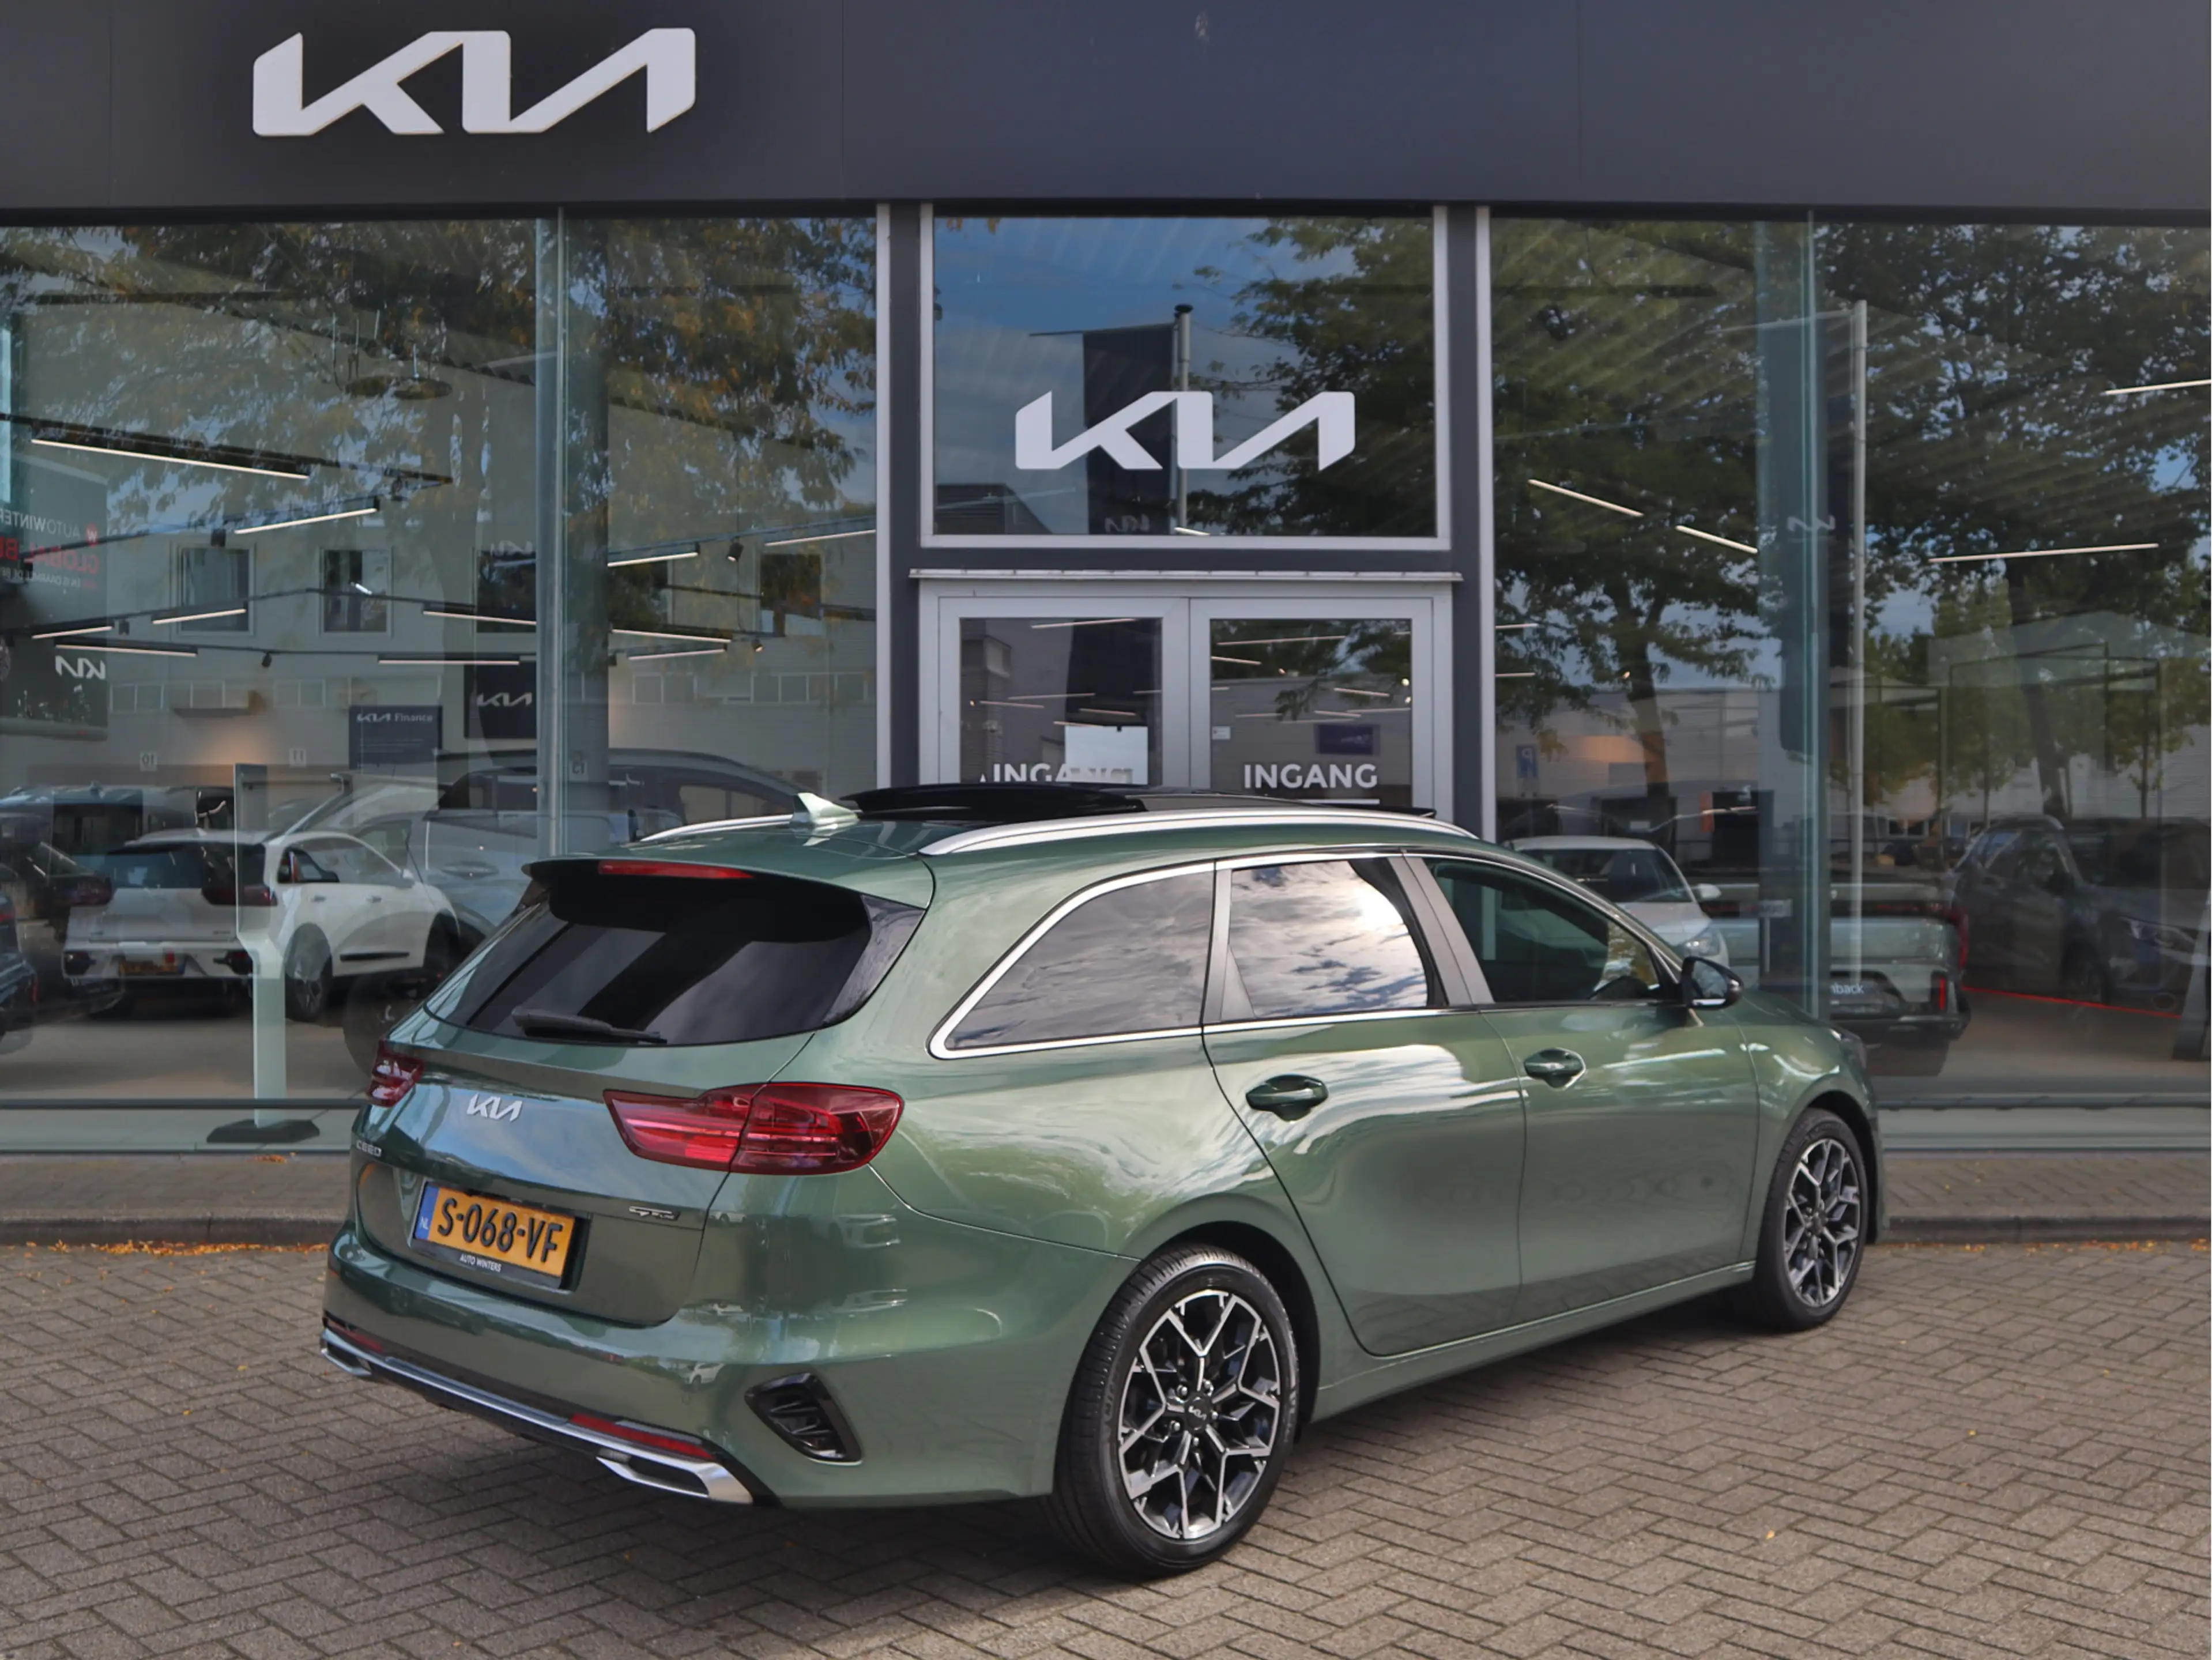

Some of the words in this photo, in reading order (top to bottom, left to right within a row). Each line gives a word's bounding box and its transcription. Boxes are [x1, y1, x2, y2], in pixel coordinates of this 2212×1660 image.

[253, 28, 696, 136] KIA
[1015, 391, 1355, 471] KIA
[476, 693, 532, 707] KIA
[357, 713, 391, 723] KIA
[394, 712, 433, 722] Finance
[1244, 764, 1378, 788] INGANG
[467, 1093, 523, 1122] KIA
[420, 1216, 429, 1231] NL
[438, 1197, 563, 1263] S-068-VF
[459, 1253, 476, 1266] AUTO
[476, 1257, 502, 1273] WINTERS
